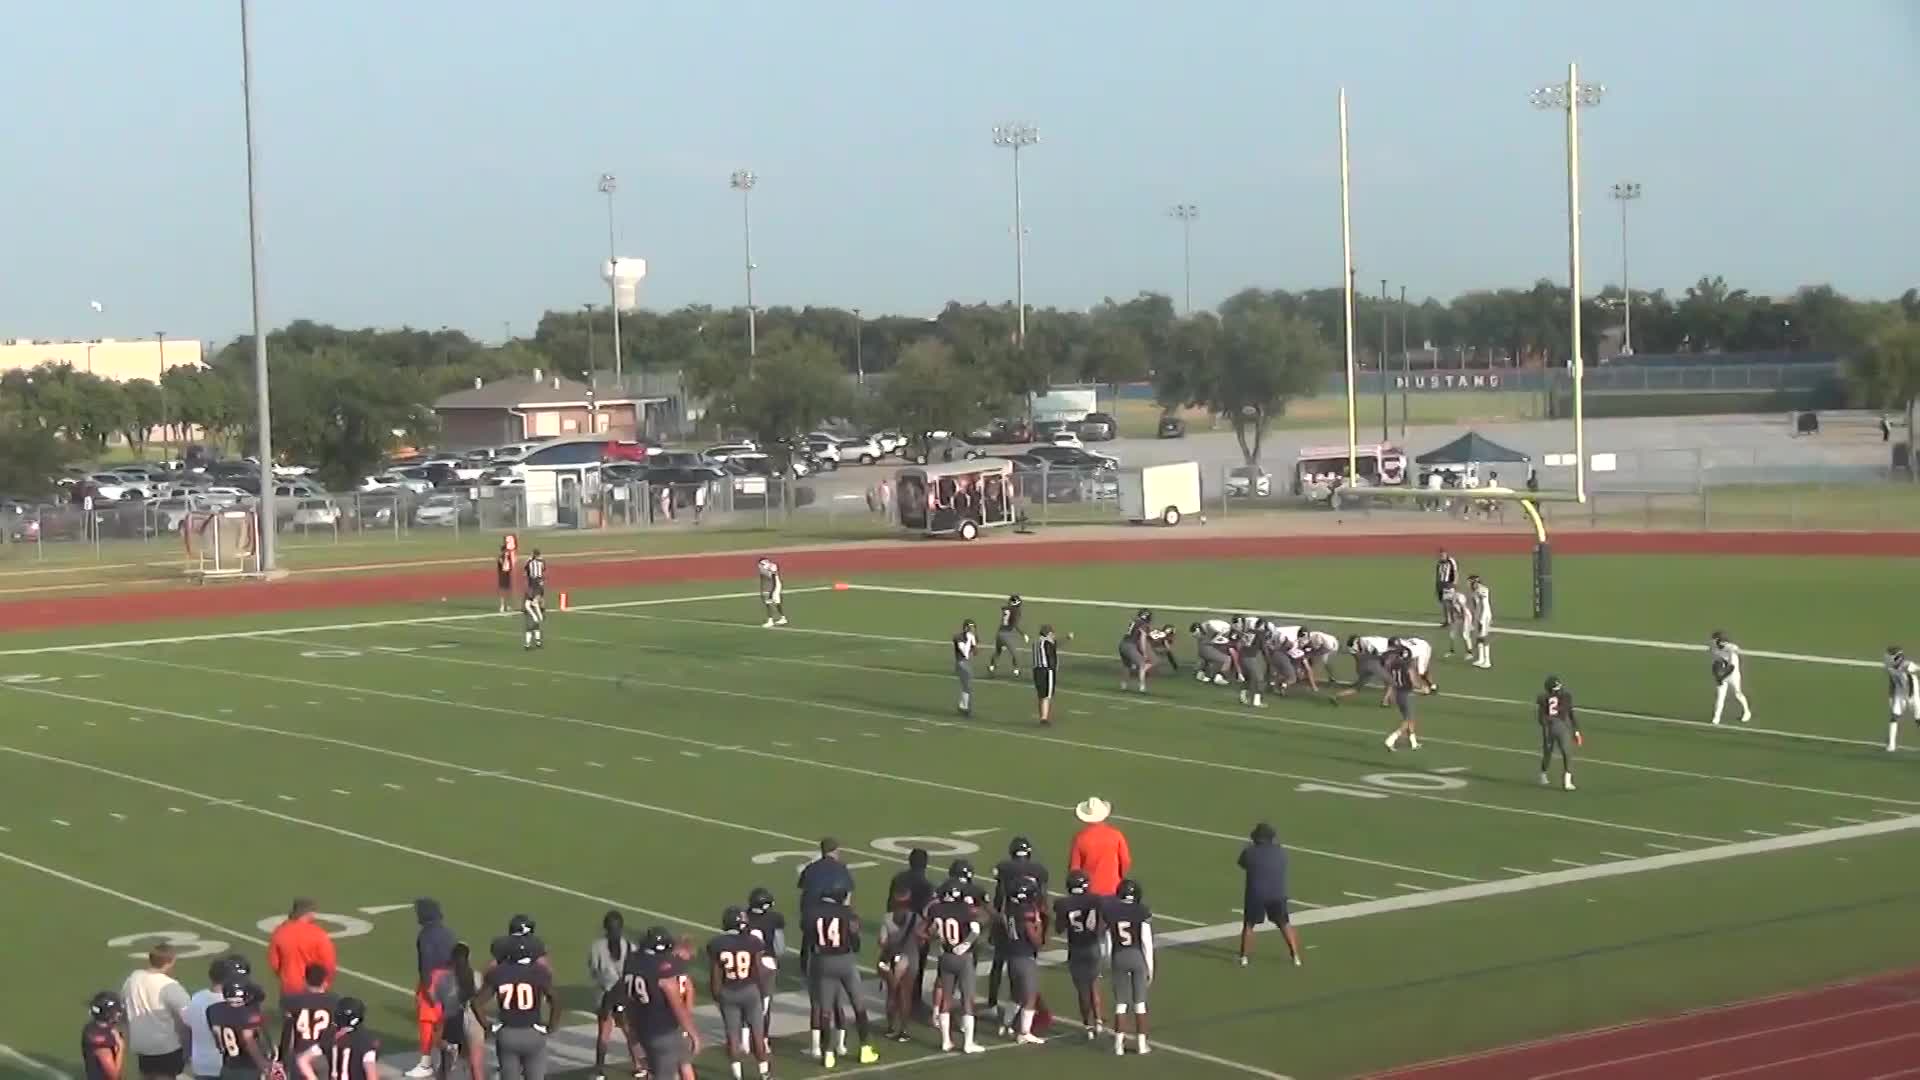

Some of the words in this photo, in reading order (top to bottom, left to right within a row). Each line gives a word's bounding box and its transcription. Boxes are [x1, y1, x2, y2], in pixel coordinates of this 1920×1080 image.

[1549, 696, 1559, 716] 2
[1294, 773, 1468, 799] 10
[107, 912, 375, 959] 30
[816, 917, 841, 948] 14
[1117, 920, 1133, 947] 5
[719, 951, 751, 980] 28
[498, 983, 534, 1011] 70
[296, 1008, 331, 1041] 42
